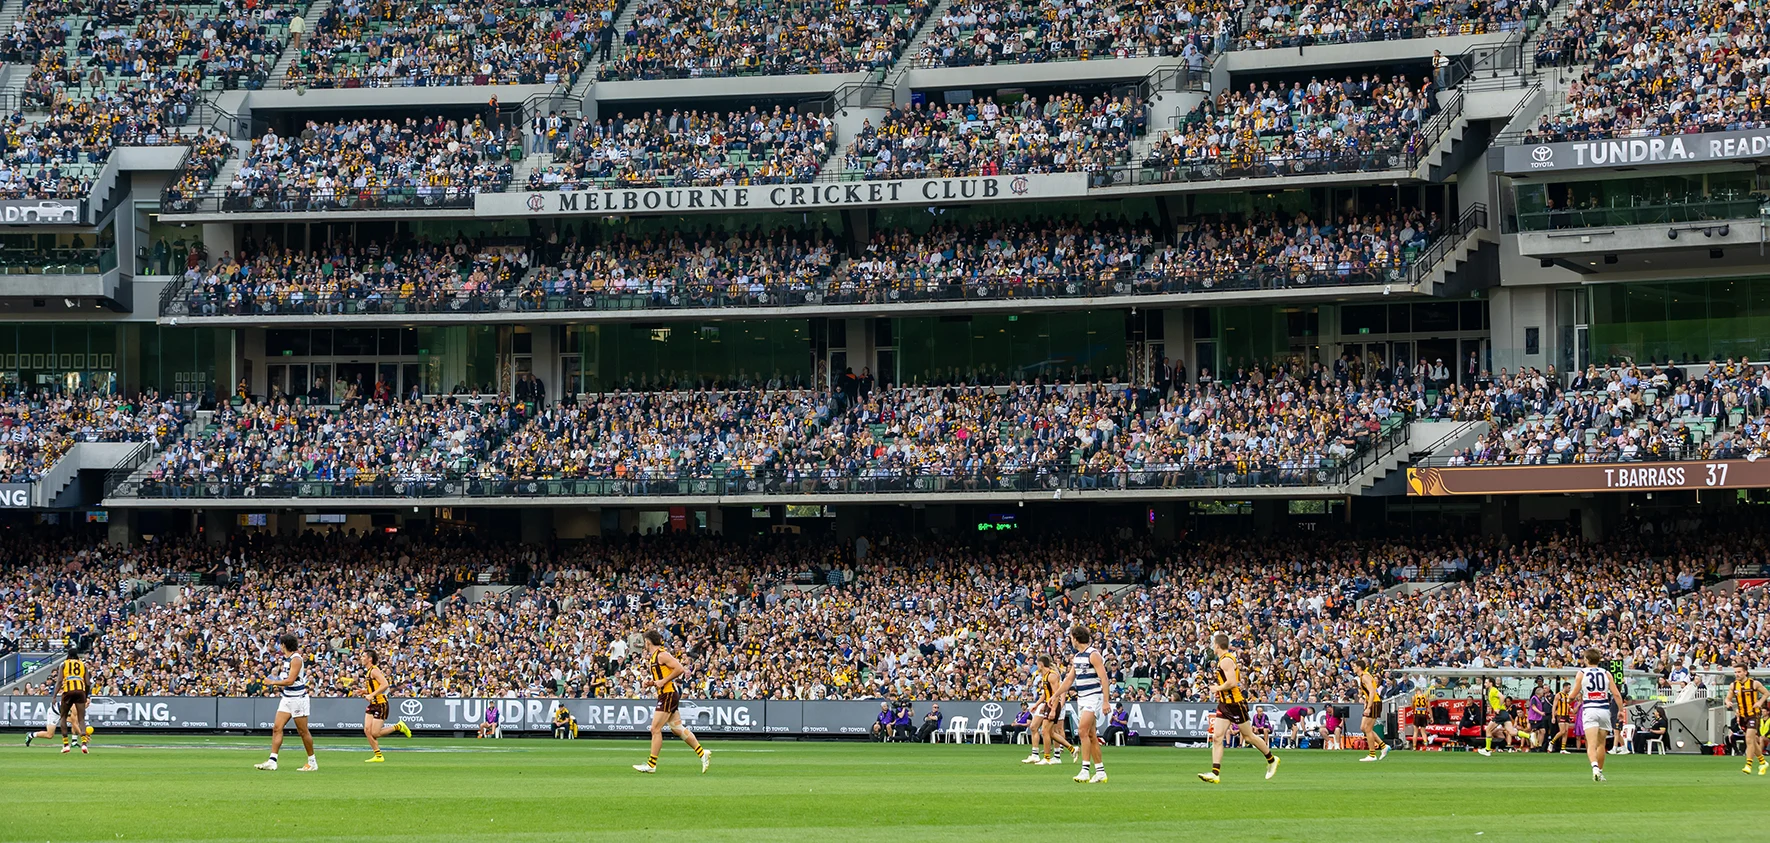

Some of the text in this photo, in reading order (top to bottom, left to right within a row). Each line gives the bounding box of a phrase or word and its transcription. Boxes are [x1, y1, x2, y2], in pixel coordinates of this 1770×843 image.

[1573, 135, 1770, 166] TUNDRA. READ
[559, 188, 749, 212] MELBOURNE
[770, 181, 902, 206] CRICKET
[922, 178, 999, 199] CLUB
[1605, 463, 1729, 488] T.BARRASS 37
[68, 661, 81, 676] 18
[1586, 671, 1606, 692] 30
[3, 702, 47, 720] REA
[1416, 697, 1426, 708] 33
[1453, 701, 1464, 709] KFC
[1170, 709, 1209, 730] REA
